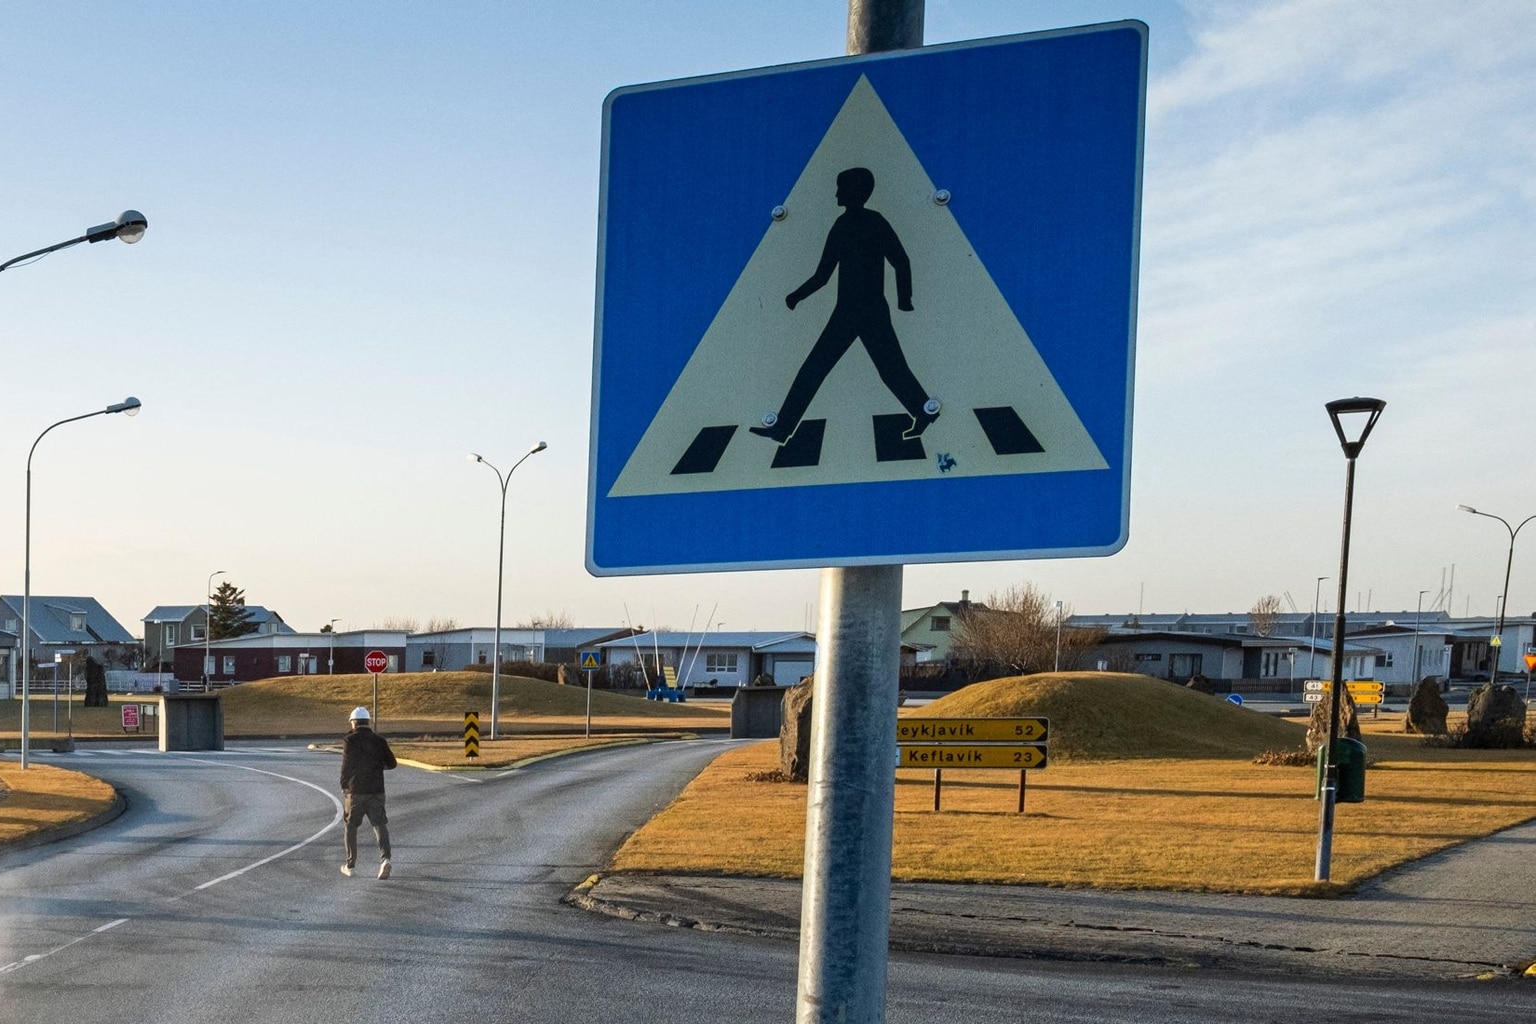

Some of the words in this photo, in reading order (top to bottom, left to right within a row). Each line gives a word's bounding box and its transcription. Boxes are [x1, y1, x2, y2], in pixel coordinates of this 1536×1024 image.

[367, 658, 386, 666] STOP
[897, 724, 974, 738] eykjavík
[1015, 725, 1033, 736] 52
[909, 750, 982, 762] Keflavík
[1014, 752, 1032, 762] 23
